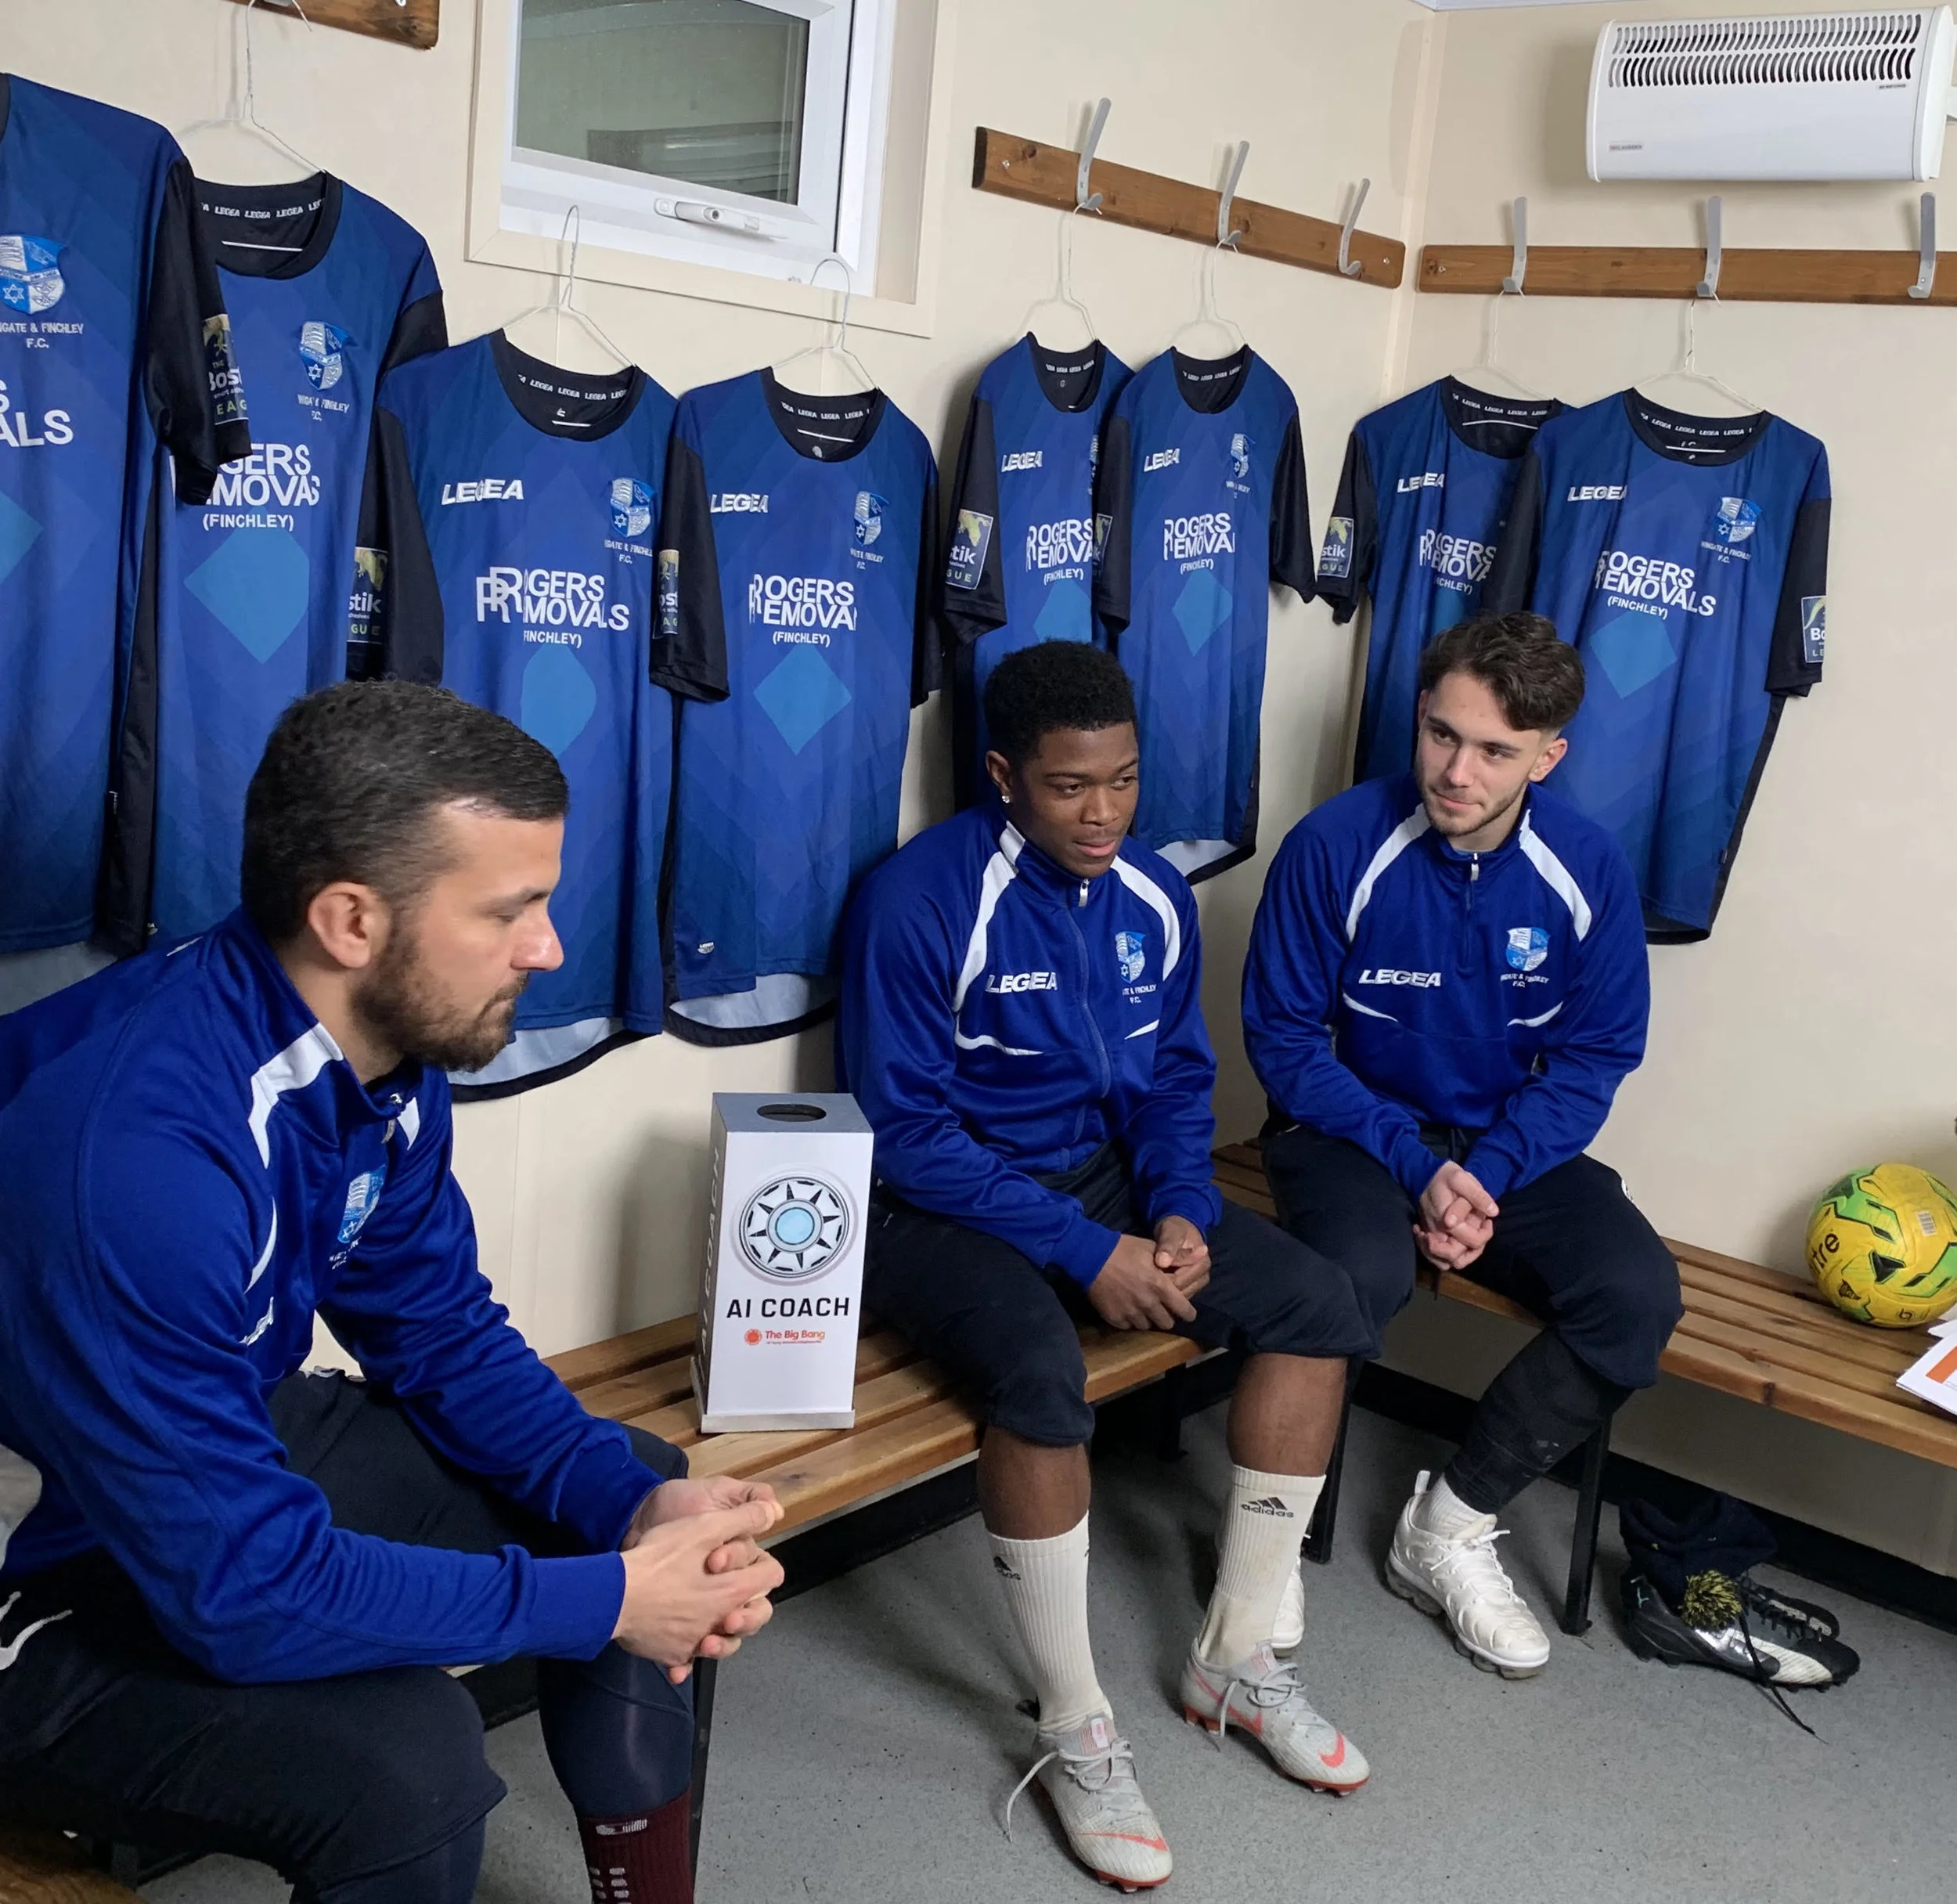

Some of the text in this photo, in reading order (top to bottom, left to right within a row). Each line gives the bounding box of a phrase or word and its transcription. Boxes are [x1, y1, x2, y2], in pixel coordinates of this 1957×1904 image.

[276, 206, 304, 218] LEGEA
[31, 323, 38, 333] &
[41, 323, 84, 334] FINCHLEY
[26, 337, 49, 348] F.C.
[529, 379, 553, 392] LEGEA
[557, 387, 580, 398] LEGEA
[1397, 472, 1445, 493] LEEA
[710, 493, 769, 514] LEGEA
[202, 514, 294, 532] (FINCHLEY)
[1607, 595, 1668, 620] (FINCHLEY)
[773, 630, 831, 648] (FINCHLEY)
[985, 972, 1058, 994] LEGEA
[1358, 968, 1442, 988] LEGEA
[726, 1296, 849, 1318] AI COACH
[765, 1329, 825, 1340] The Big Bang
[1241, 1503, 1295, 1519] adidas
